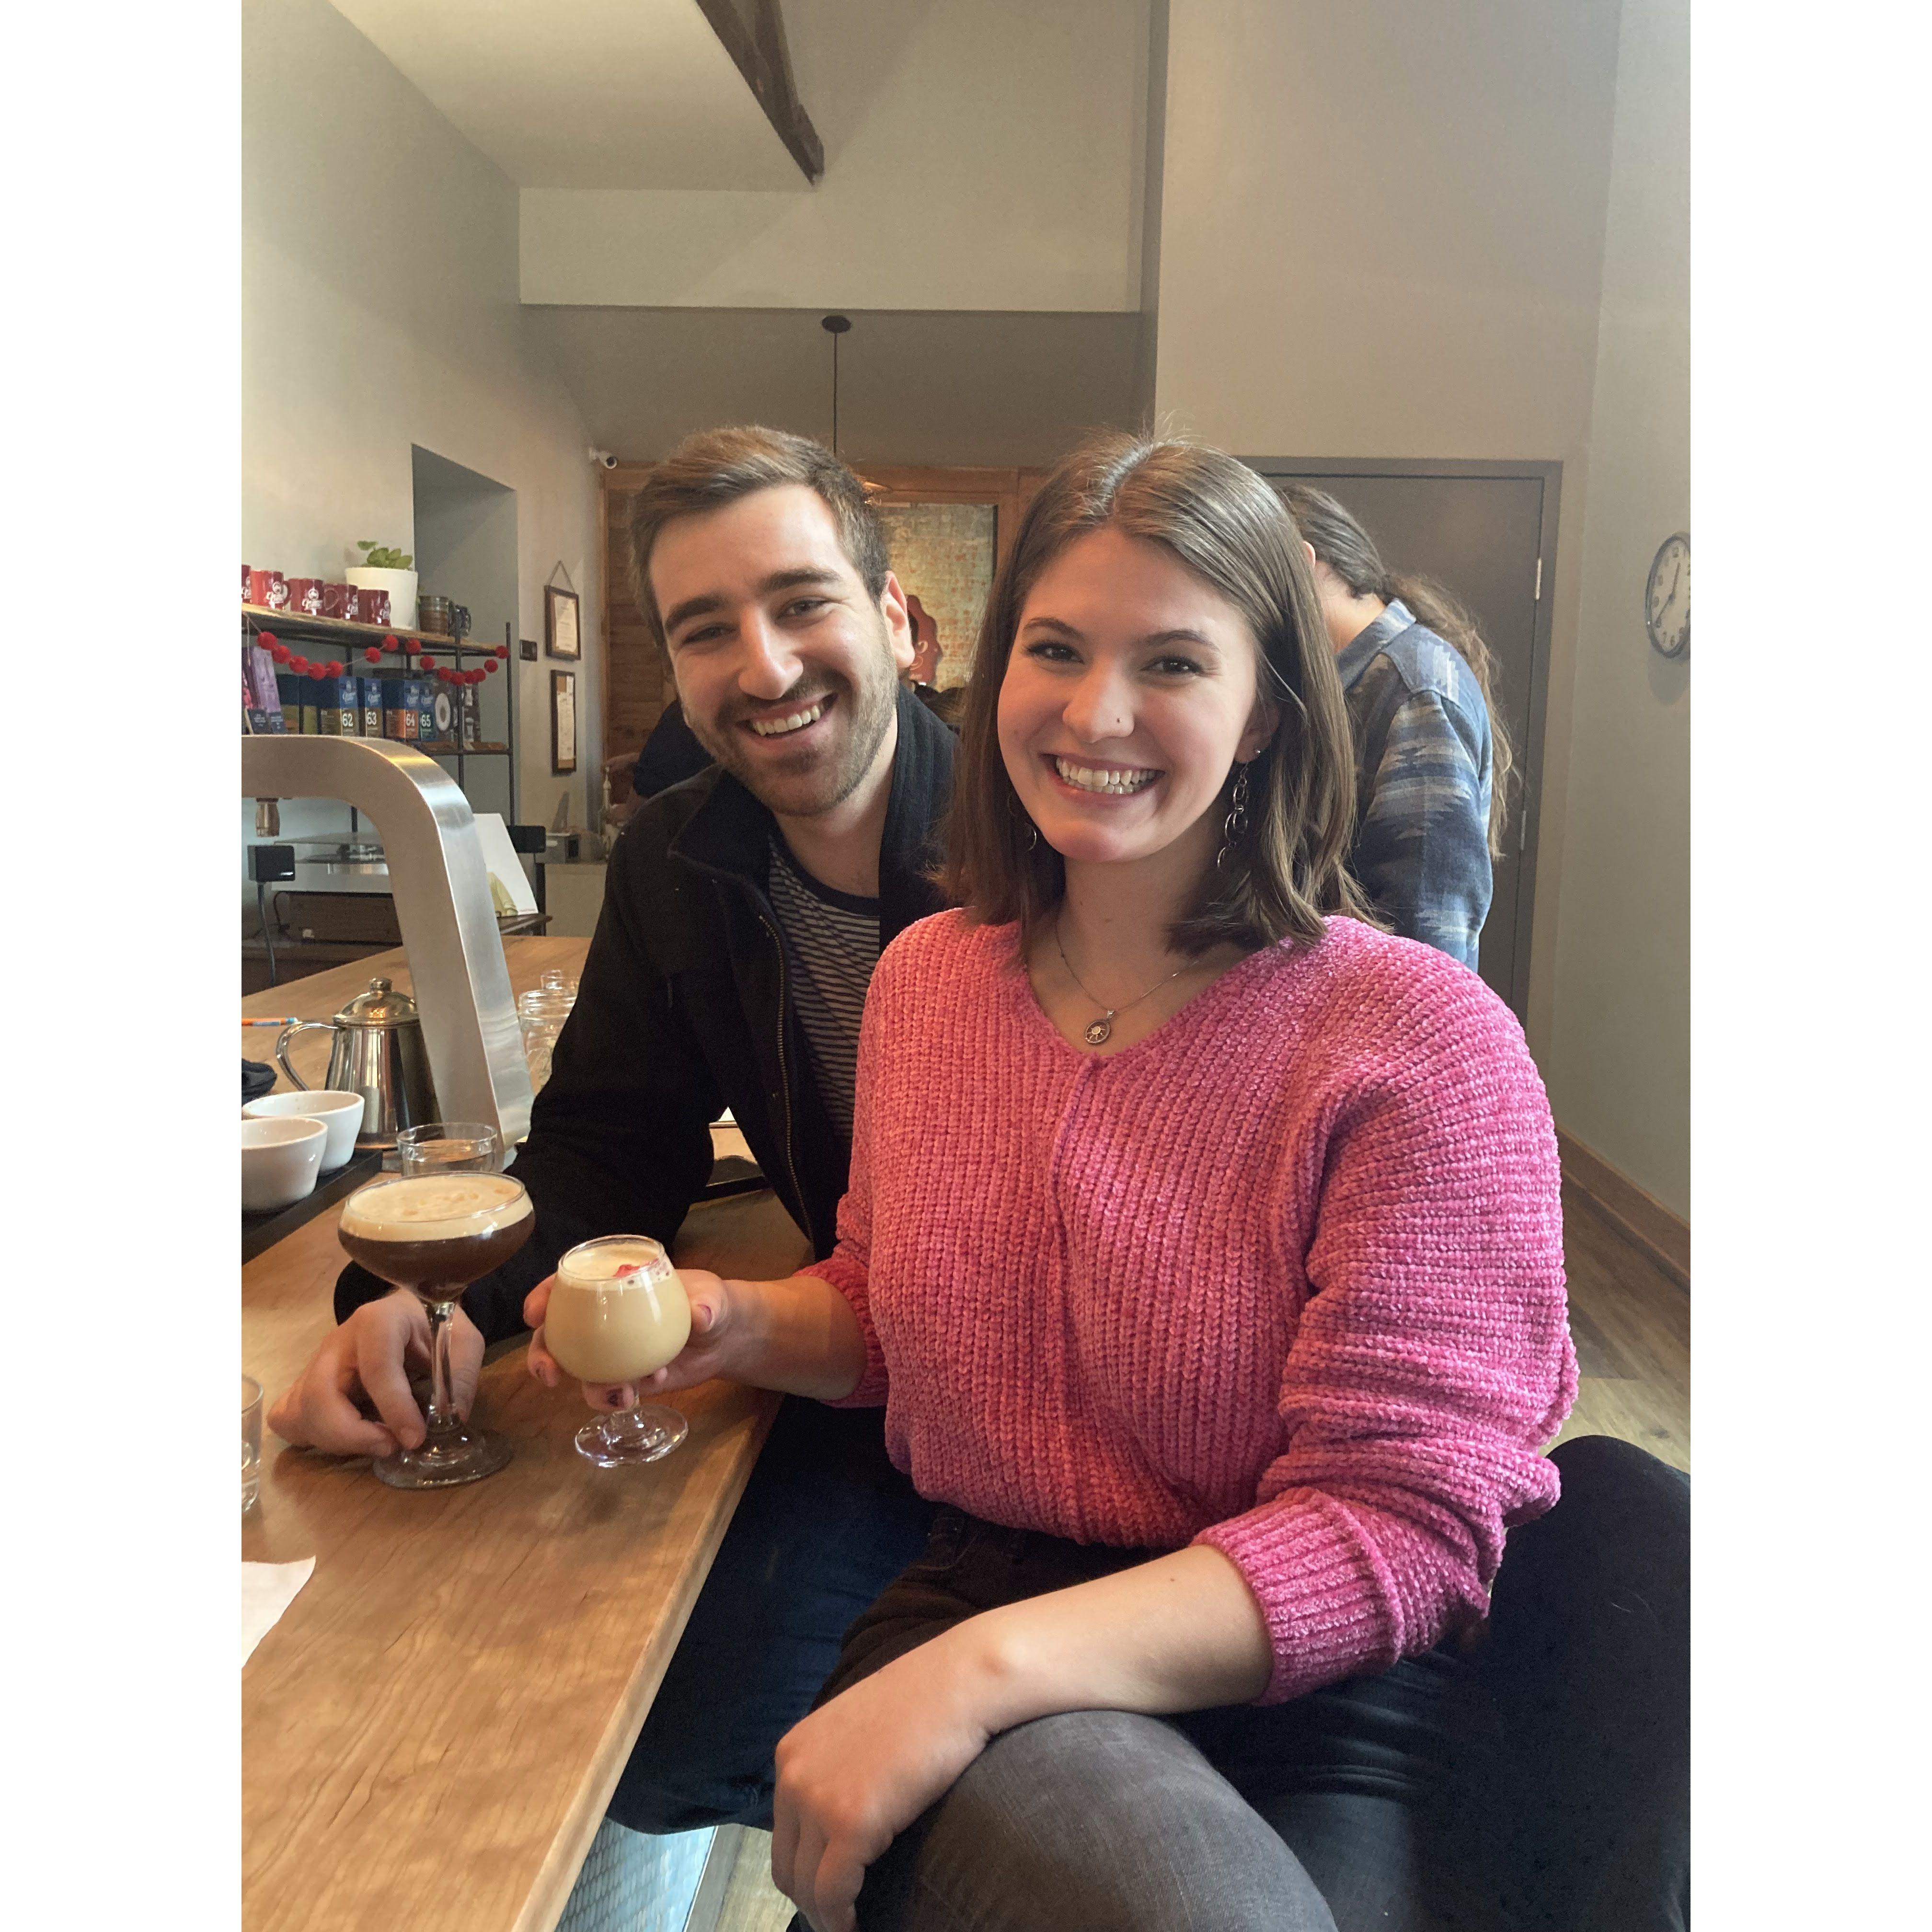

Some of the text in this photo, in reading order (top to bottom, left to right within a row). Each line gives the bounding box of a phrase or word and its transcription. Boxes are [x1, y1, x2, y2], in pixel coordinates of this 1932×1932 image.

[342, 713, 353, 727] 62
[367, 712, 377, 725] 63
[406, 713, 415, 726] 64
[421, 714, 431, 727] 65
